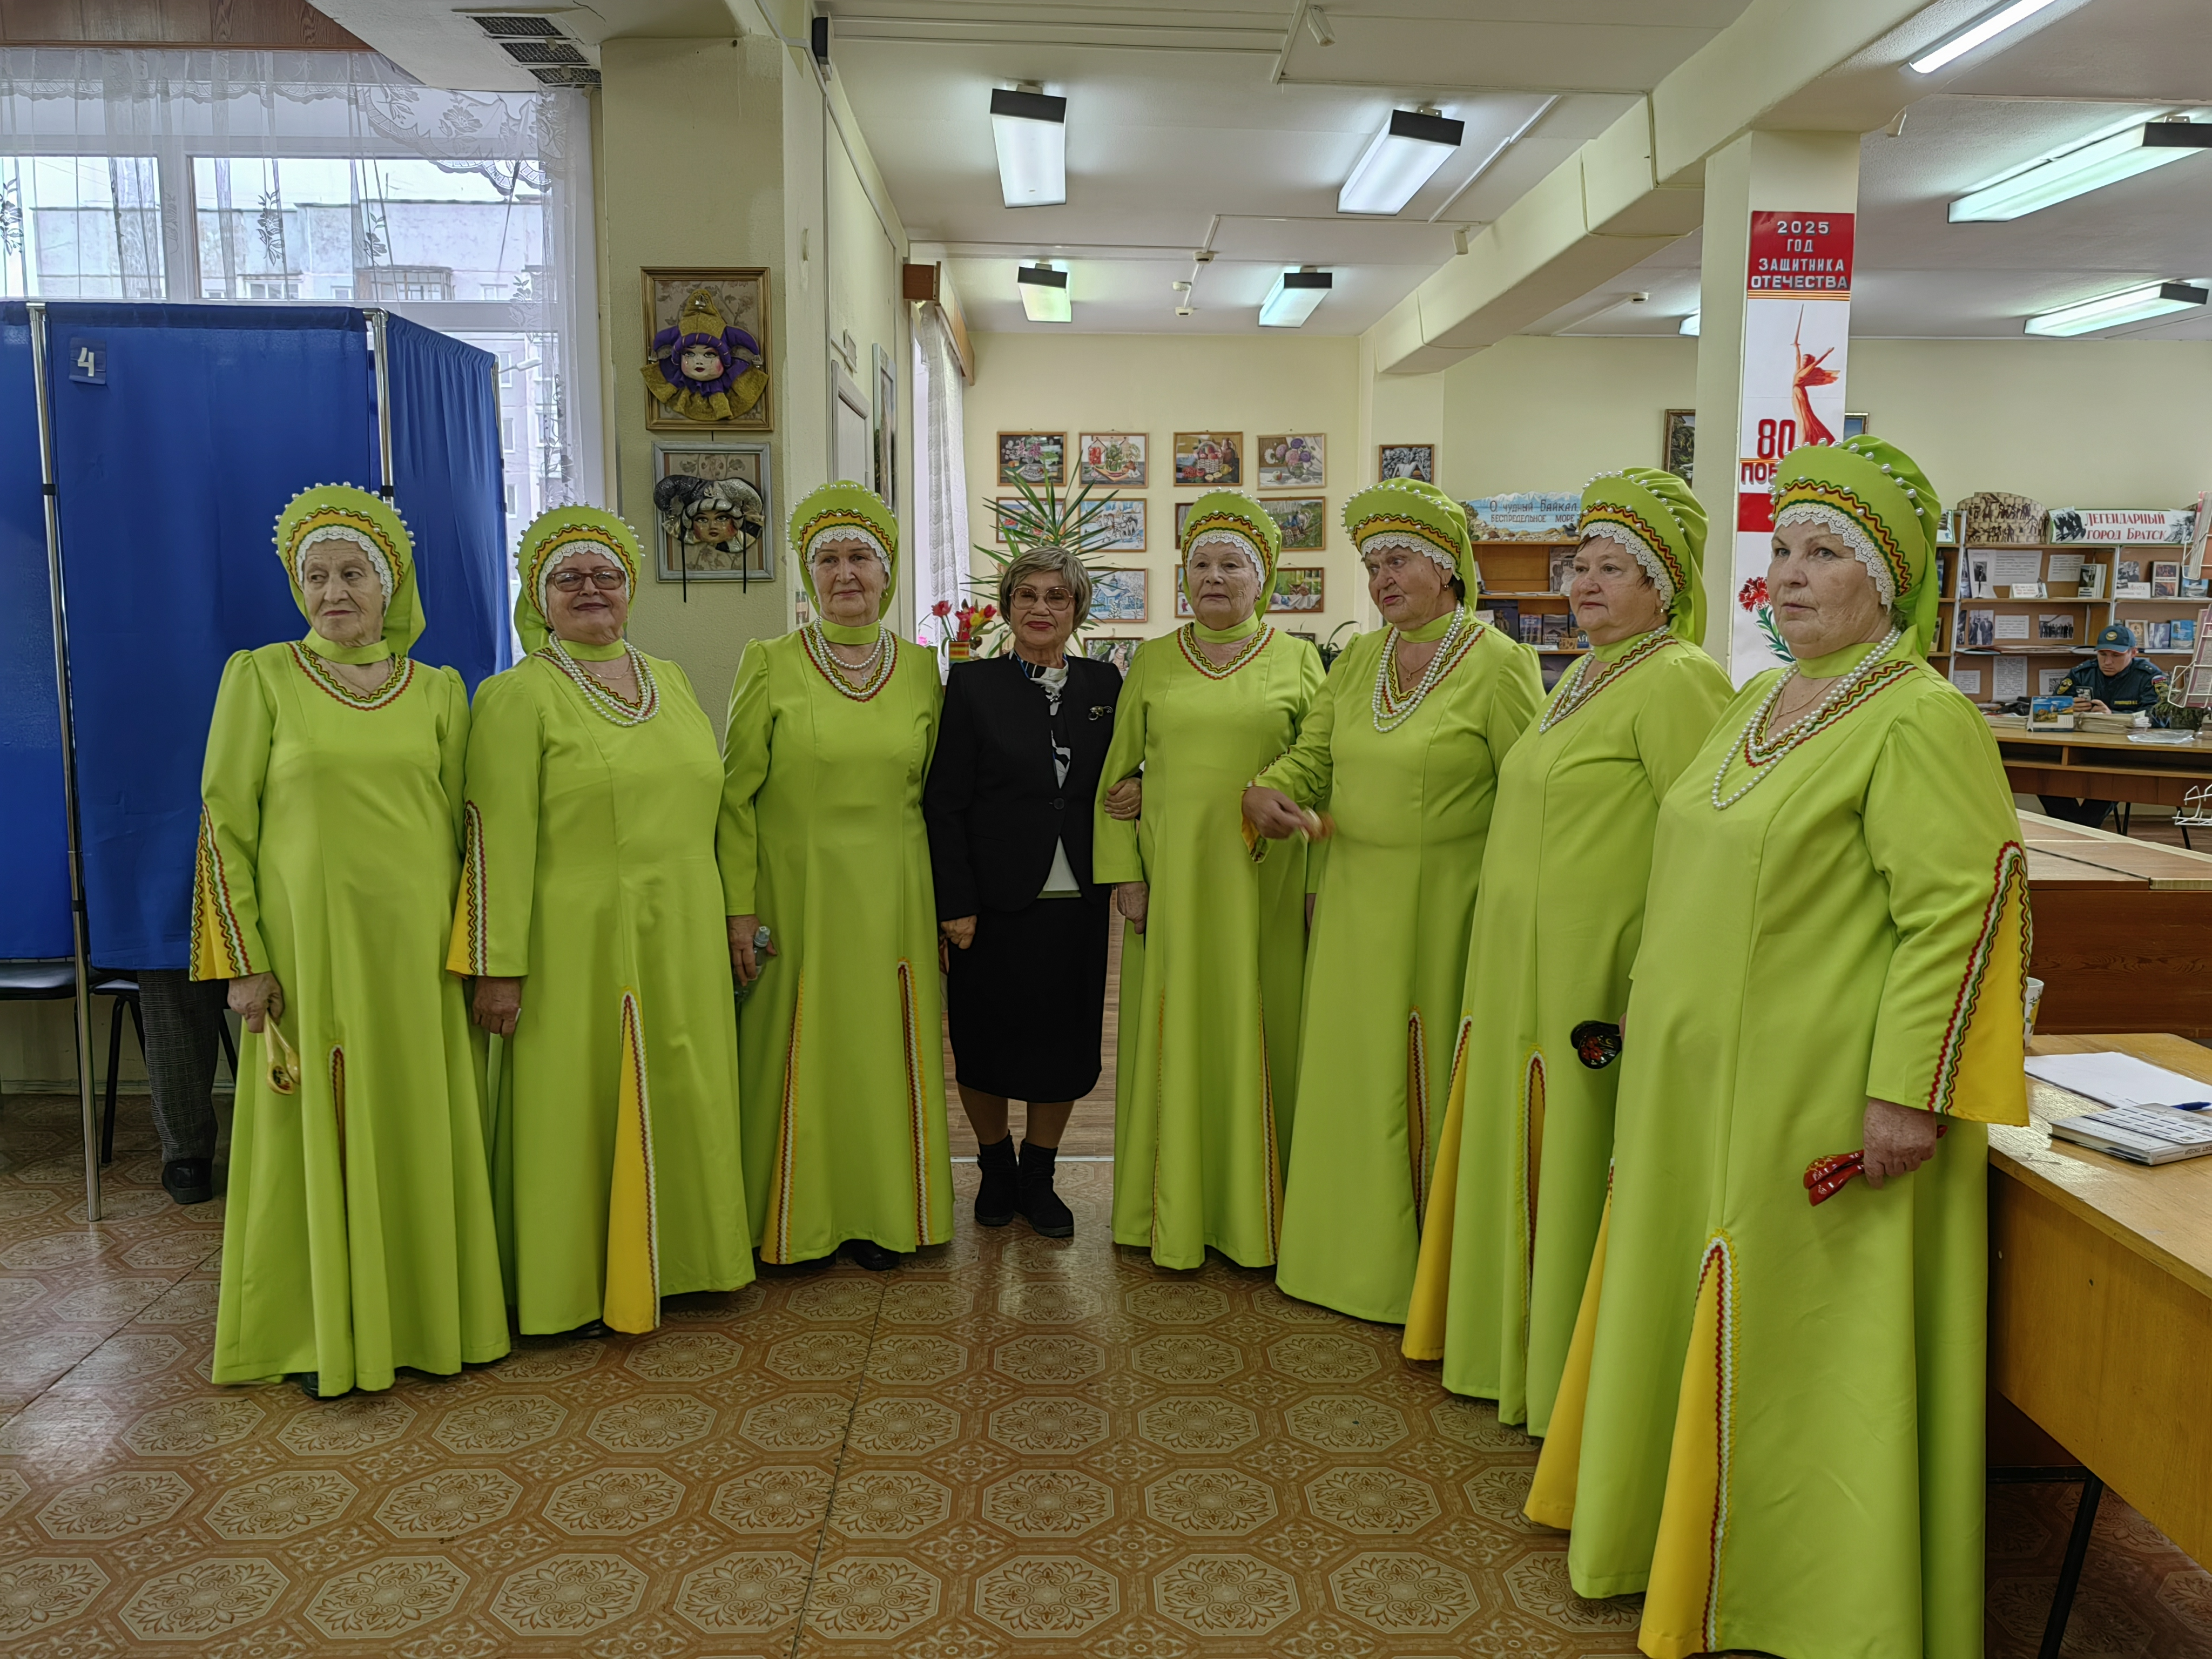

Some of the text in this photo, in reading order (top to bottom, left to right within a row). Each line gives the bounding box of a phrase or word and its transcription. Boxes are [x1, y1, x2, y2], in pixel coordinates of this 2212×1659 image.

[1777, 220, 1830, 234] 2025
[1787, 239, 1813, 252] ГОД
[1758, 258, 1844, 271] ЗАЩИТНИКА
[1751, 275, 1847, 288] ОТЕЧЕСТВА
[77, 347, 95, 377] 4
[1757, 419, 1796, 460] 80
[1491, 514, 1575, 523] БЕСПРЕДЕЛЬНОЕ МОРЕ
[2085, 512, 2165, 527] ЛЕГЕНДАРНЫЙ
[2087, 530, 2121, 539] ГОРОД
